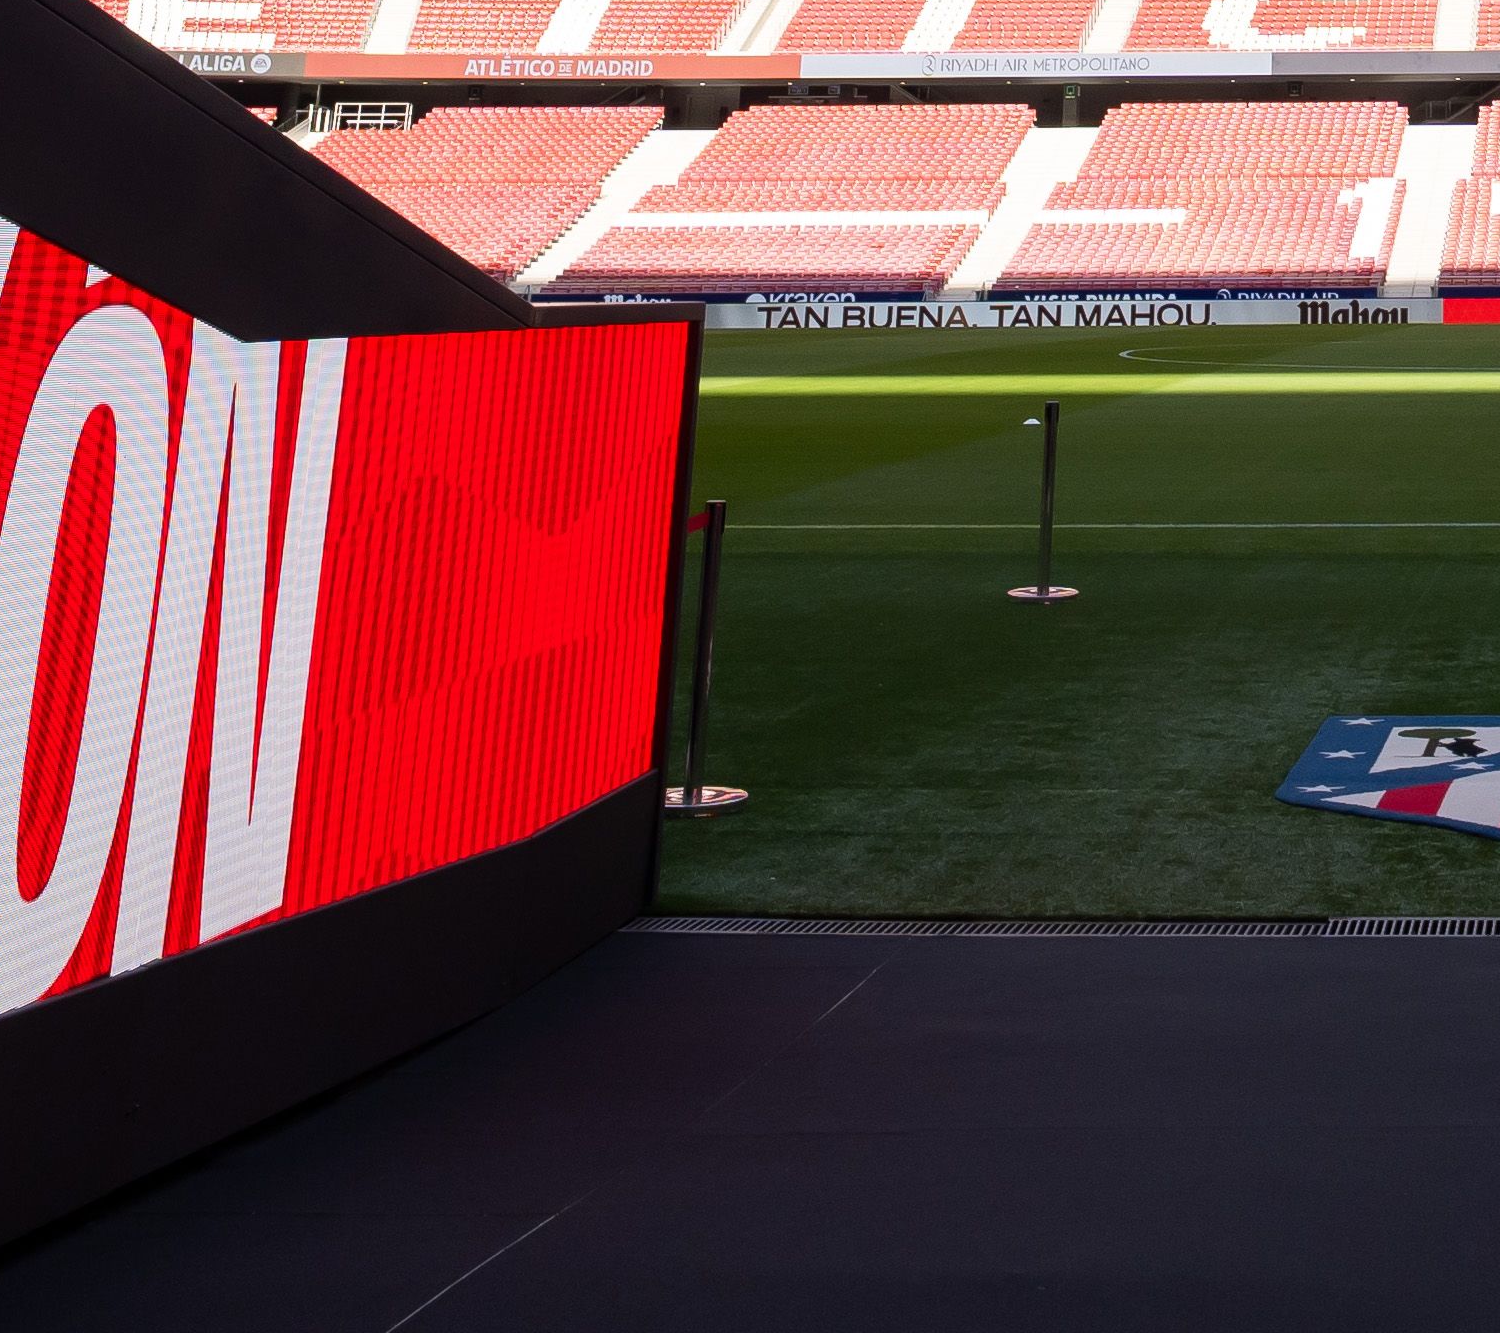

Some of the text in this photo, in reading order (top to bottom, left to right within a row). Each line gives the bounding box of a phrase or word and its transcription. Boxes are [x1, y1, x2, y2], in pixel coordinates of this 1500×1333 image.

[464, 54, 654, 77] ATLÉTICO DE MADRID
[939, 58, 998, 73] RIYADH
[1001, 58, 1029, 73] AIR
[1033, 56, 1151, 73] METROPOLITANO
[756, 303, 1217, 329] TAN BUENA. TAN MAHOU.
[1296, 299, 1409, 325] Mahou
